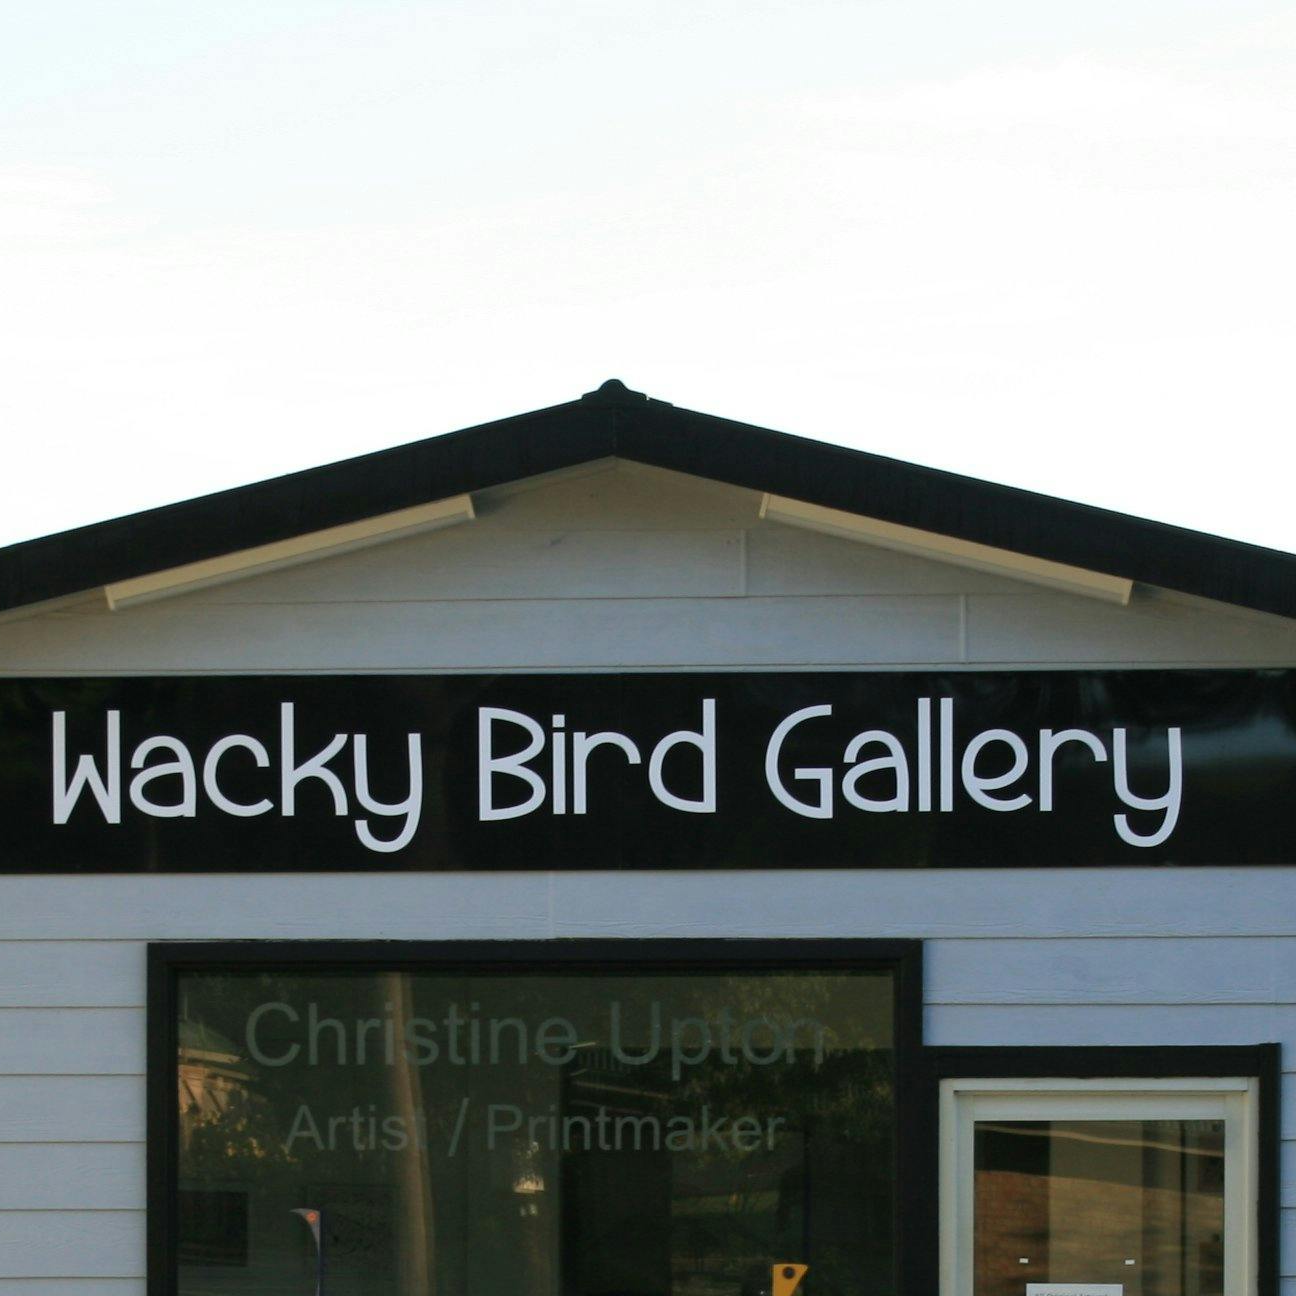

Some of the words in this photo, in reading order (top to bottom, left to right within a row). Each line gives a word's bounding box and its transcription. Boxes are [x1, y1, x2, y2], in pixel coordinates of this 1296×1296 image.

[52, 702, 423, 853] Wacky
[478, 698, 717, 821] Bird
[765, 697, 1184, 848] Gallery
[245, 1001, 578, 1068] Christine
[610, 1001, 825, 1082] Upton
[284, 1104, 425, 1152] Artist
[486, 1104, 787, 1152] Printmaker
